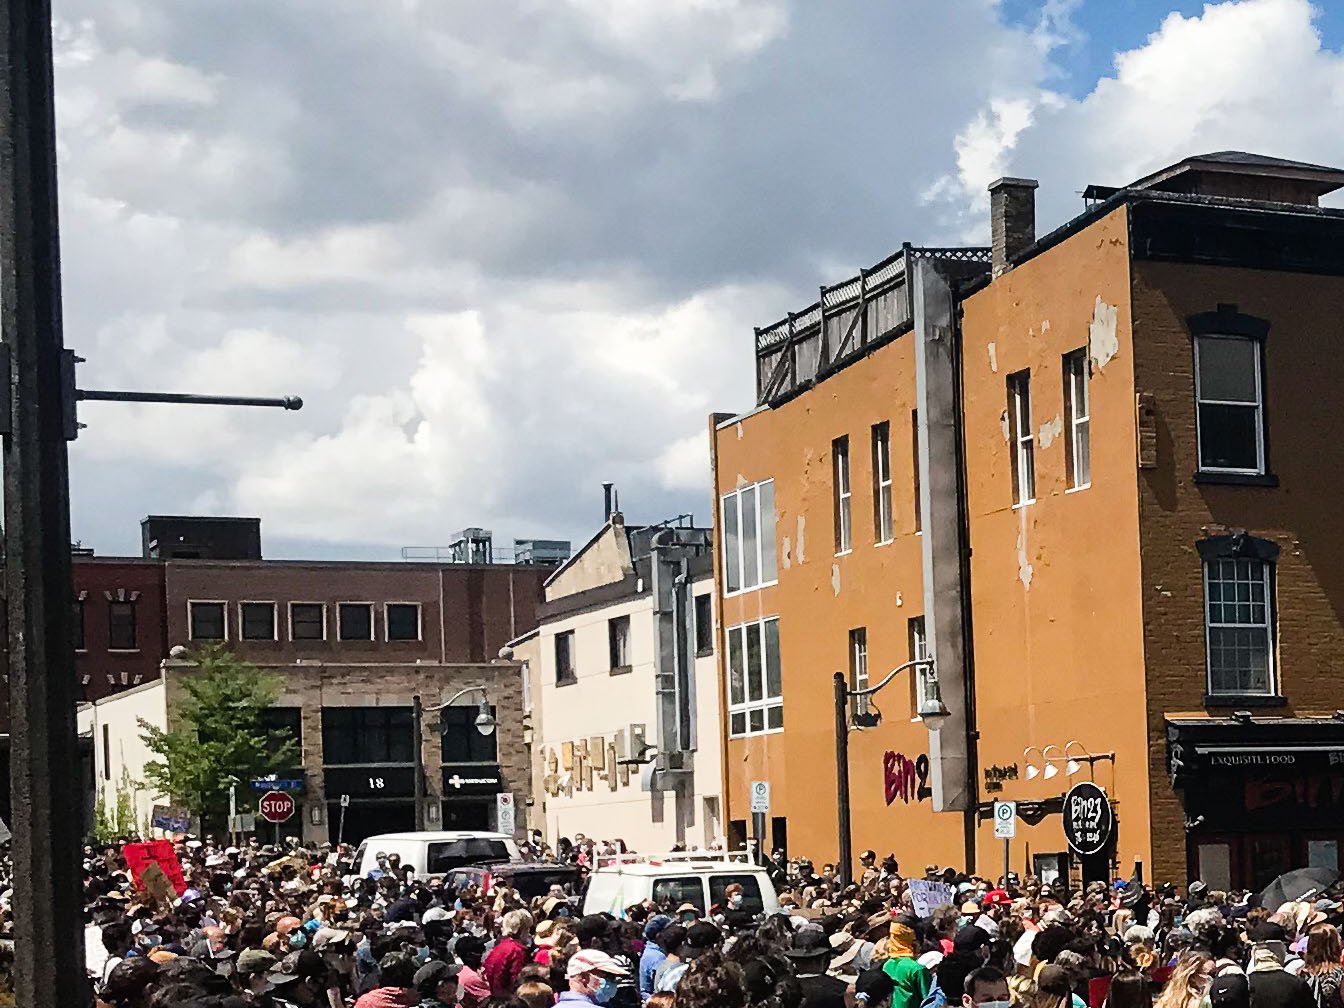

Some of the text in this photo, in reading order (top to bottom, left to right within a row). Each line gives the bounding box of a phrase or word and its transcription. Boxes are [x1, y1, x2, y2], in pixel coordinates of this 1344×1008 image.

[1266, 754, 1296, 765] FOOD
[368, 777, 385, 789] 18
[262, 801, 291, 813] STOP
